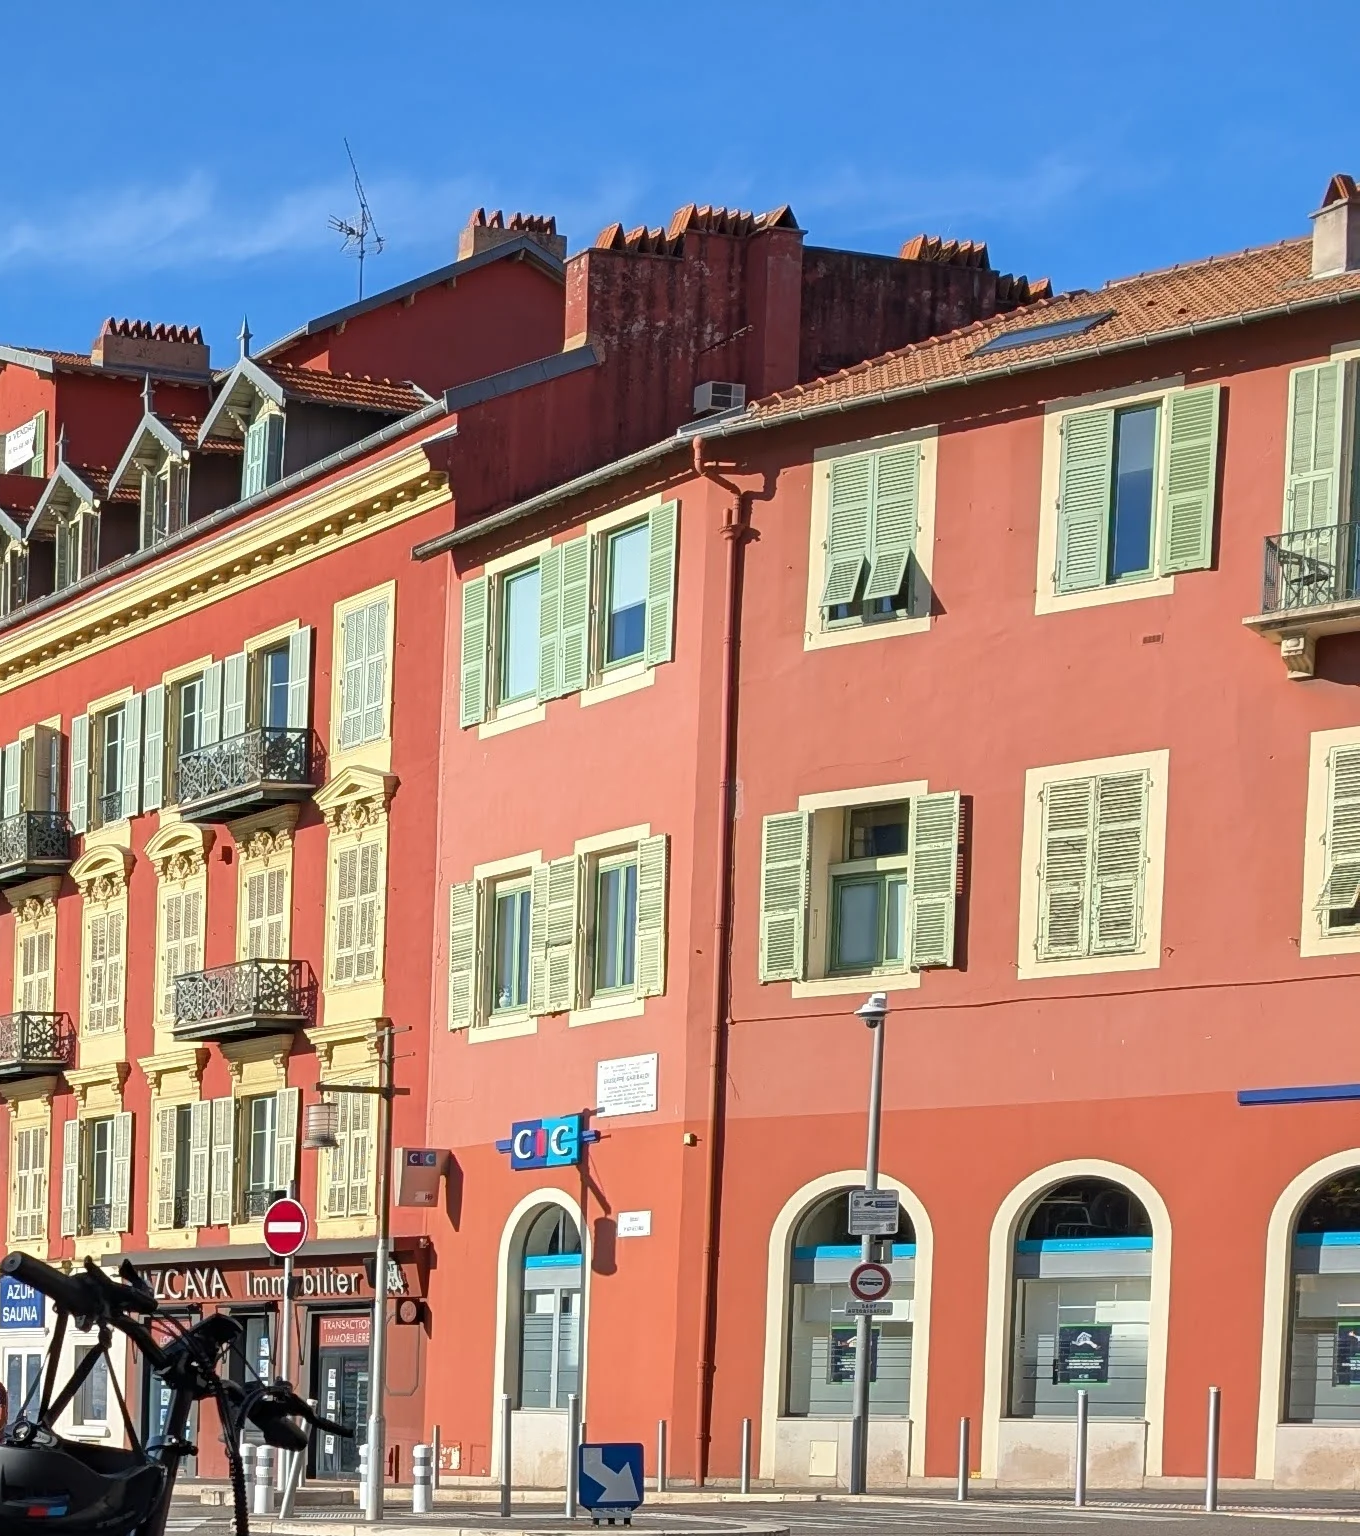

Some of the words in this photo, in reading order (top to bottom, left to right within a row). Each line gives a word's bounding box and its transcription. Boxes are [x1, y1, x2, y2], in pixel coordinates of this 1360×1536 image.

[513, 1125, 569, 1159] CIC
[409, 1153, 436, 1165] CIC
[246, 1267, 359, 1297] Immbilier
[6, 1283, 35, 1300] AZUR
[2, 1305, 38, 1323] SAUNA
